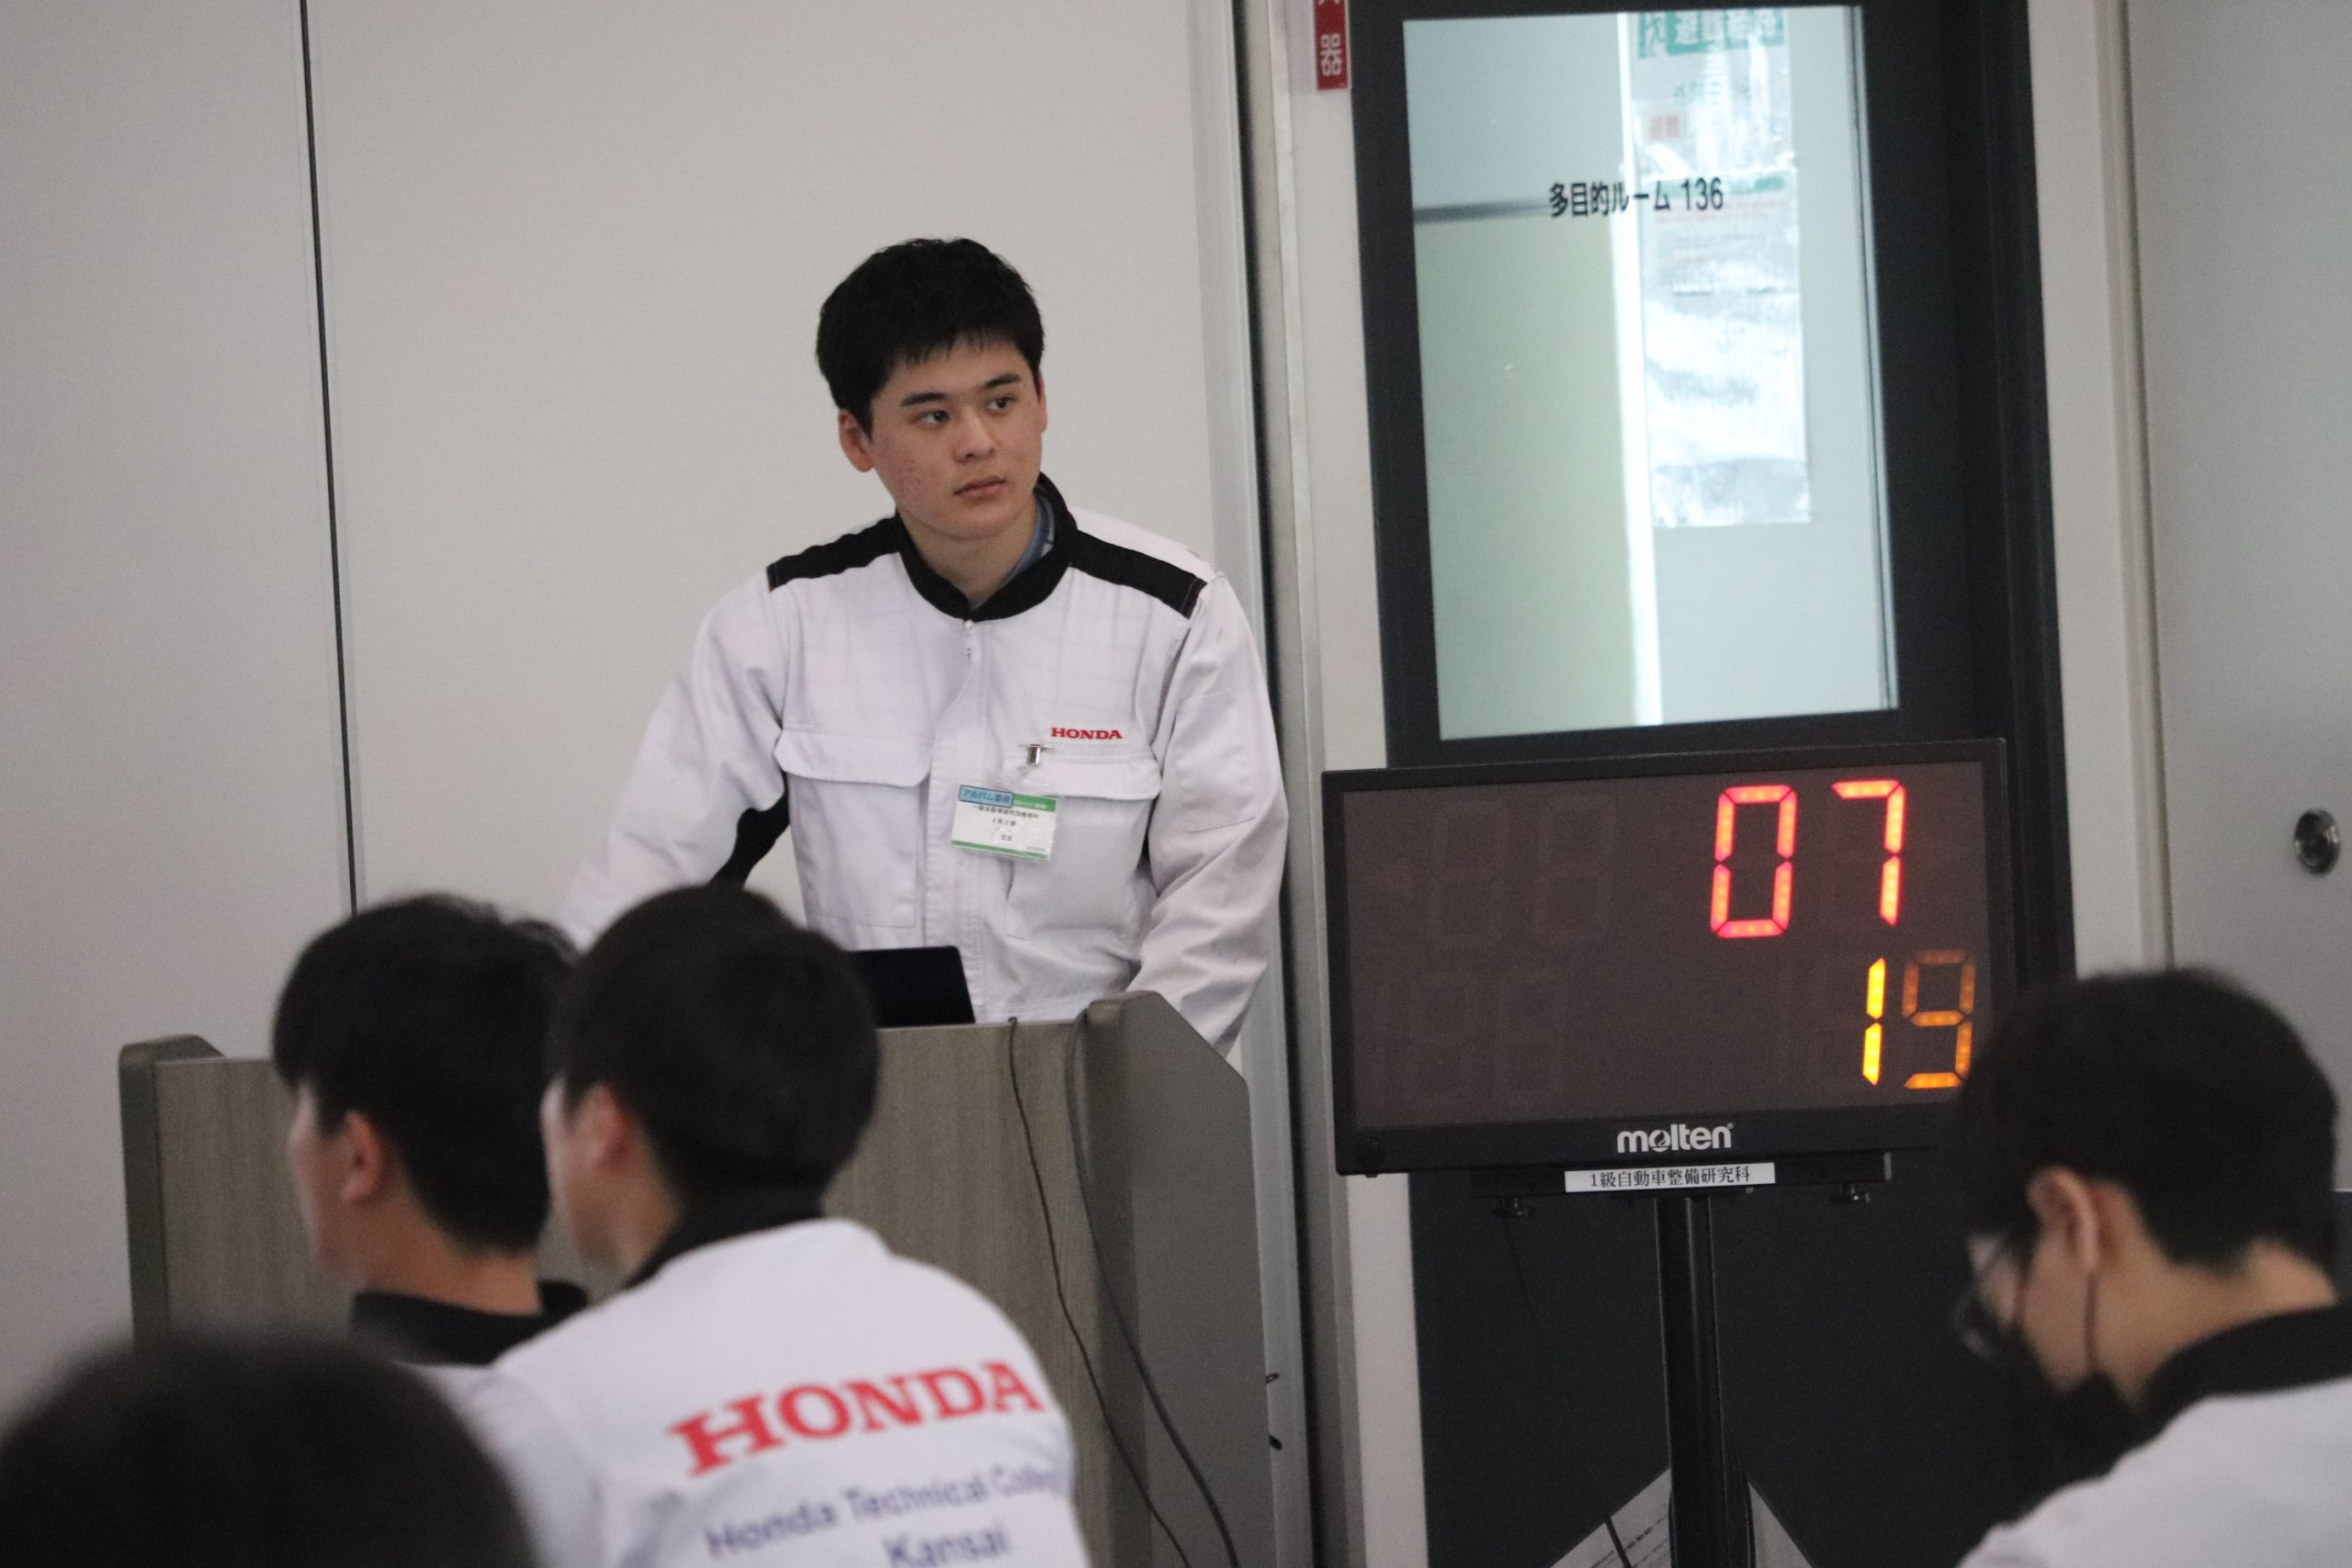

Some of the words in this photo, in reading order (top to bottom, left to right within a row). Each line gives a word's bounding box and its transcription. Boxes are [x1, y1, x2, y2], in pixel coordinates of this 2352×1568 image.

[1318, 0, 1342, 76] 器
[1549, 181, 1670, 217] 多目的ルーム
[1680, 176, 1724, 210] 136
[1050, 727, 1124, 739] HONDA
[1710, 780, 1905, 939] 07
[1862, 948, 1977, 1090] 19
[1617, 1123, 1732, 1153] molten
[1589, 1166, 1750, 1188] 1級自動車整備研究科
[667, 1360, 1045, 1477] HONDA
[706, 1501, 837, 1559] Honda
[842, 1473, 989, 1520] Technical
[885, 1521, 1009, 1568] Kansai
